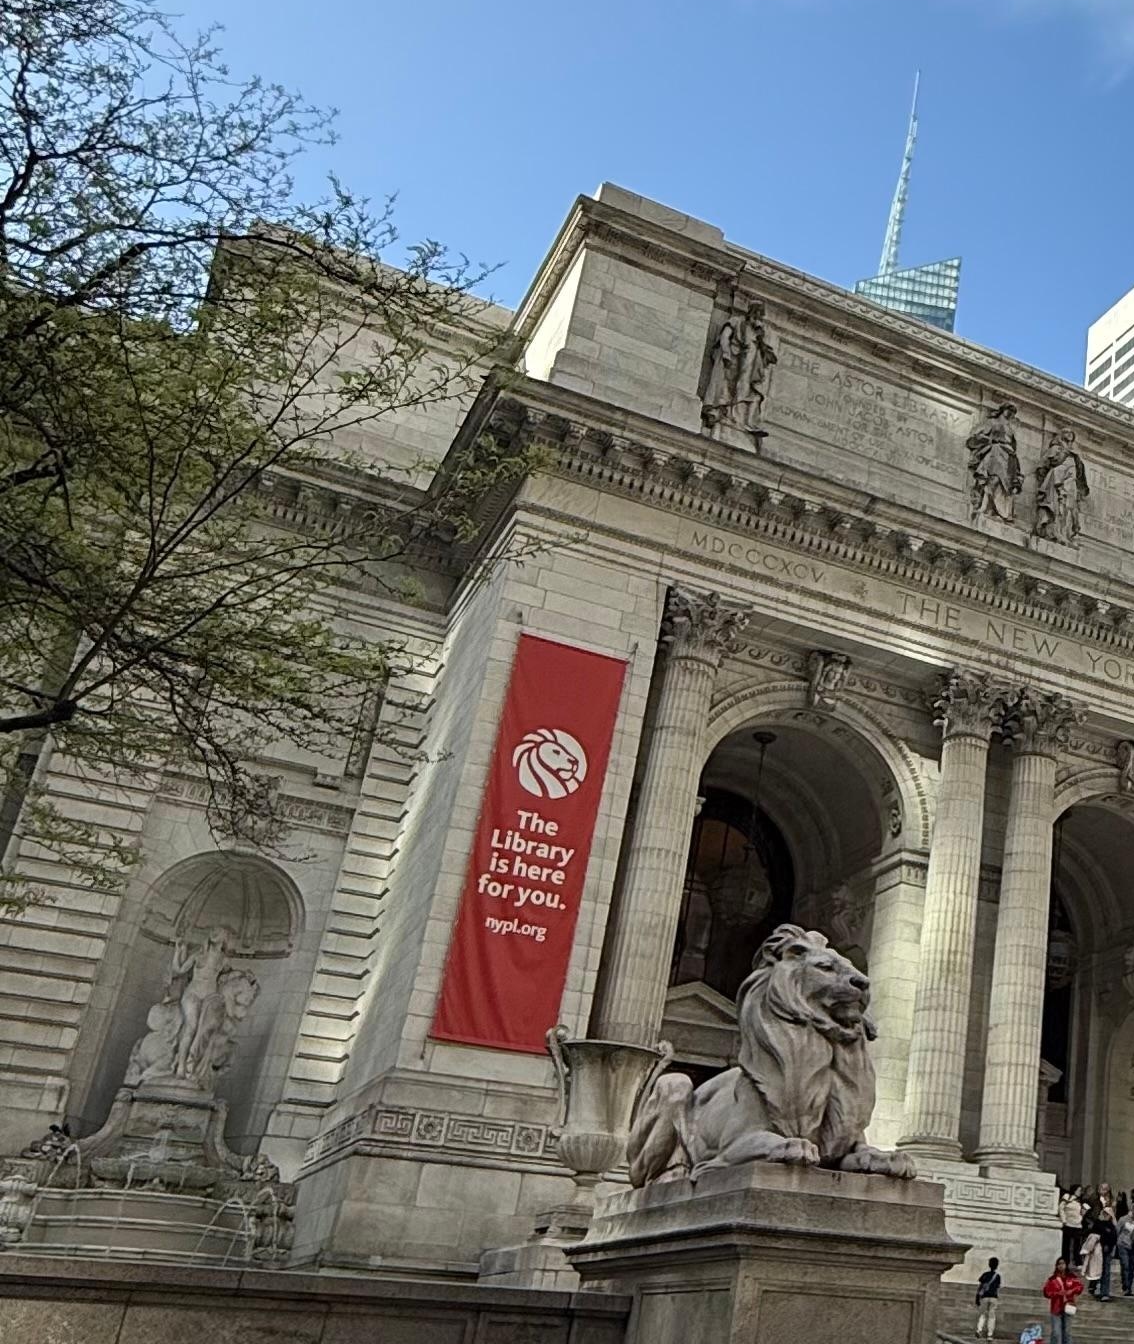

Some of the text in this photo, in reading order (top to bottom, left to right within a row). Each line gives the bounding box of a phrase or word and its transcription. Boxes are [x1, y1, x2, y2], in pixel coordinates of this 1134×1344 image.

[788, 355, 960, 422] THE ASTOR LIBRARY
[808, 393, 934, 445] JOHN JACOB ASTOR
[691, 531, 824, 583] MDCCCXCV
[897, 591, 961, 631] THE
[986, 619, 1060, 657] NEW
[517, 809, 559, 836] The
[491, 829, 575, 867] Library
[489, 851, 566, 885] is here
[478, 873, 567, 910] for you.
[485, 916, 547, 942] nypl.org
